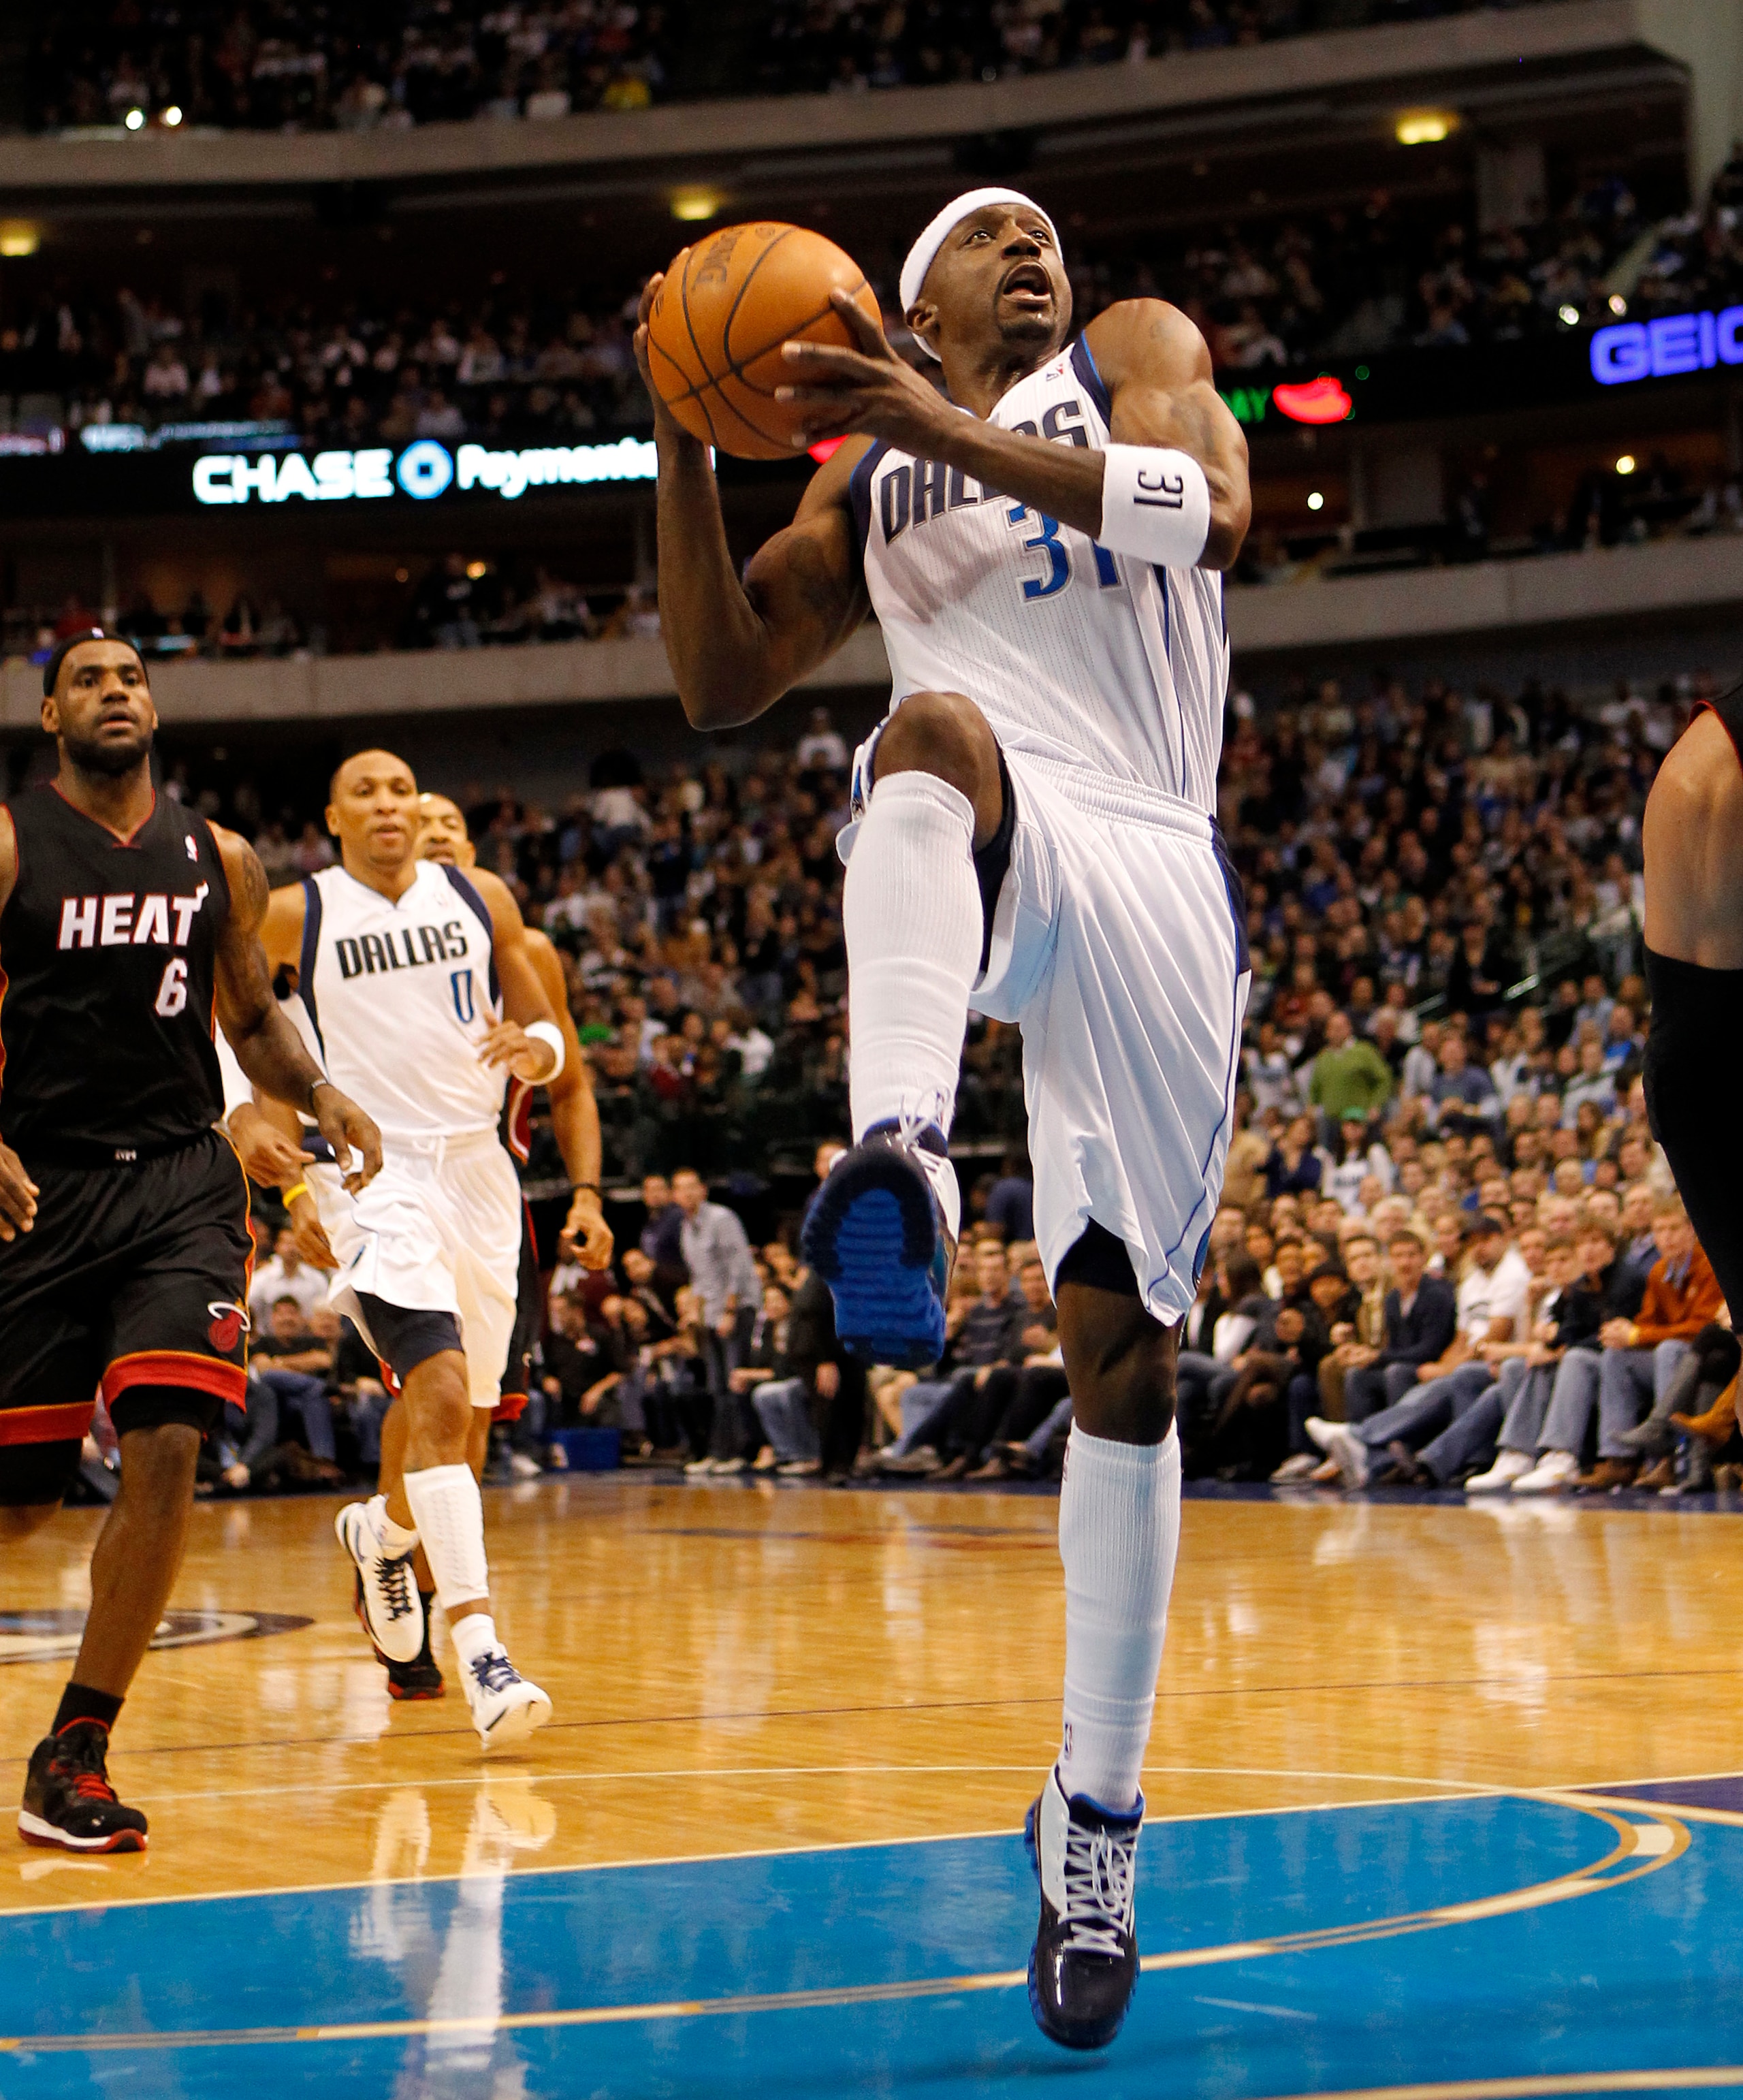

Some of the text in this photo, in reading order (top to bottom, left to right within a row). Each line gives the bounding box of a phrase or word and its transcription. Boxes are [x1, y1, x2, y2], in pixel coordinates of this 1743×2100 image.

[193, 449, 395, 505] CHASE
[1134, 470, 1184, 509] 31
[57, 880, 210, 950] HEAT
[334, 920, 469, 980] DALLAS
[154, 957, 189, 1018] 6
[449, 969, 475, 1024] 0
